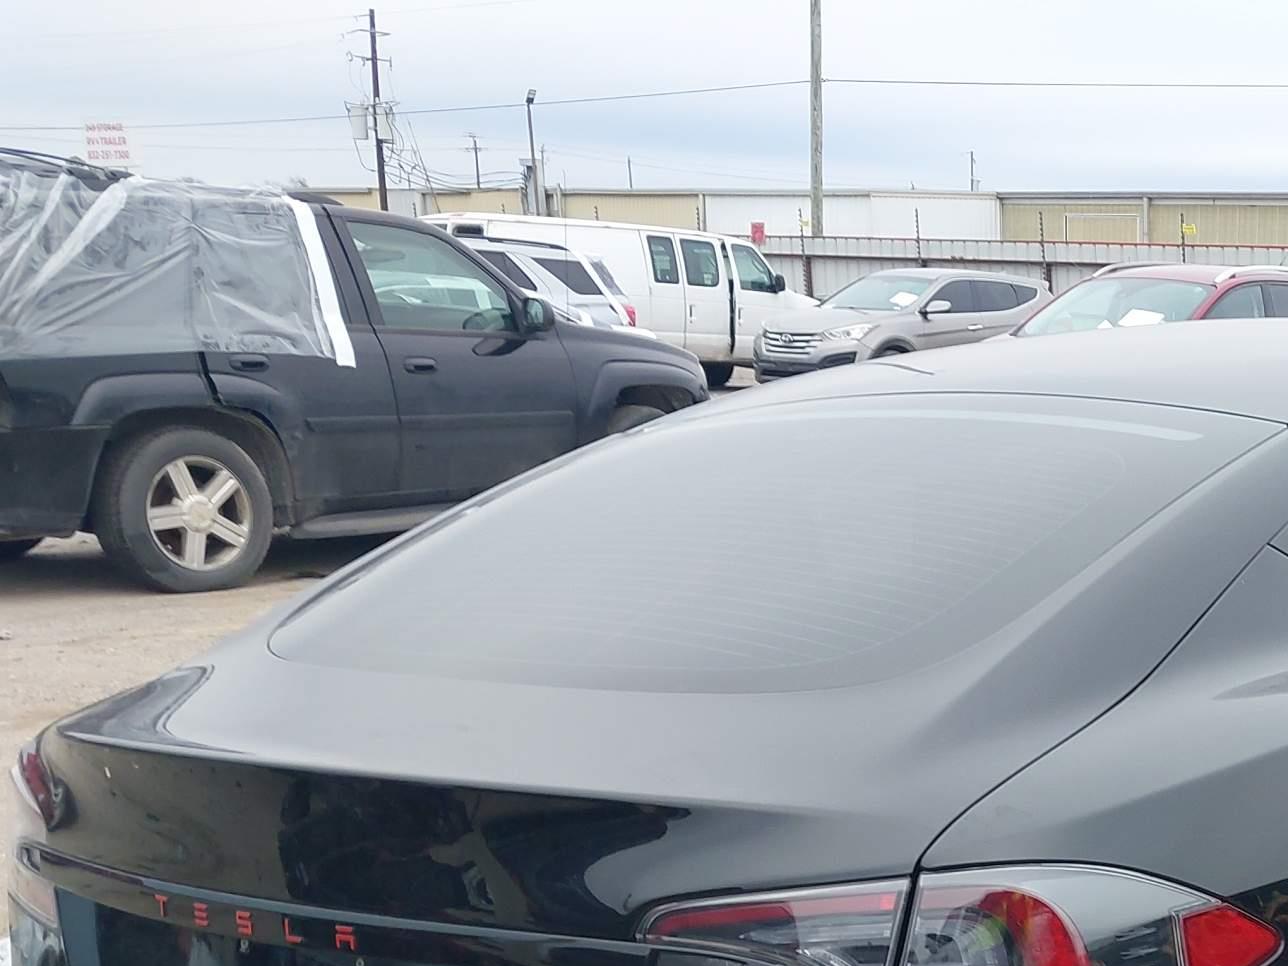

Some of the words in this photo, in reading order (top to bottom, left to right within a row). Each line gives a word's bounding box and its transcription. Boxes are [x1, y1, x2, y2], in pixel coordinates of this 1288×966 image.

[96, 123, 124, 131] STORAGE
[99, 136, 127, 145] TRAILER
[153, 893, 358, 952] TESLA
